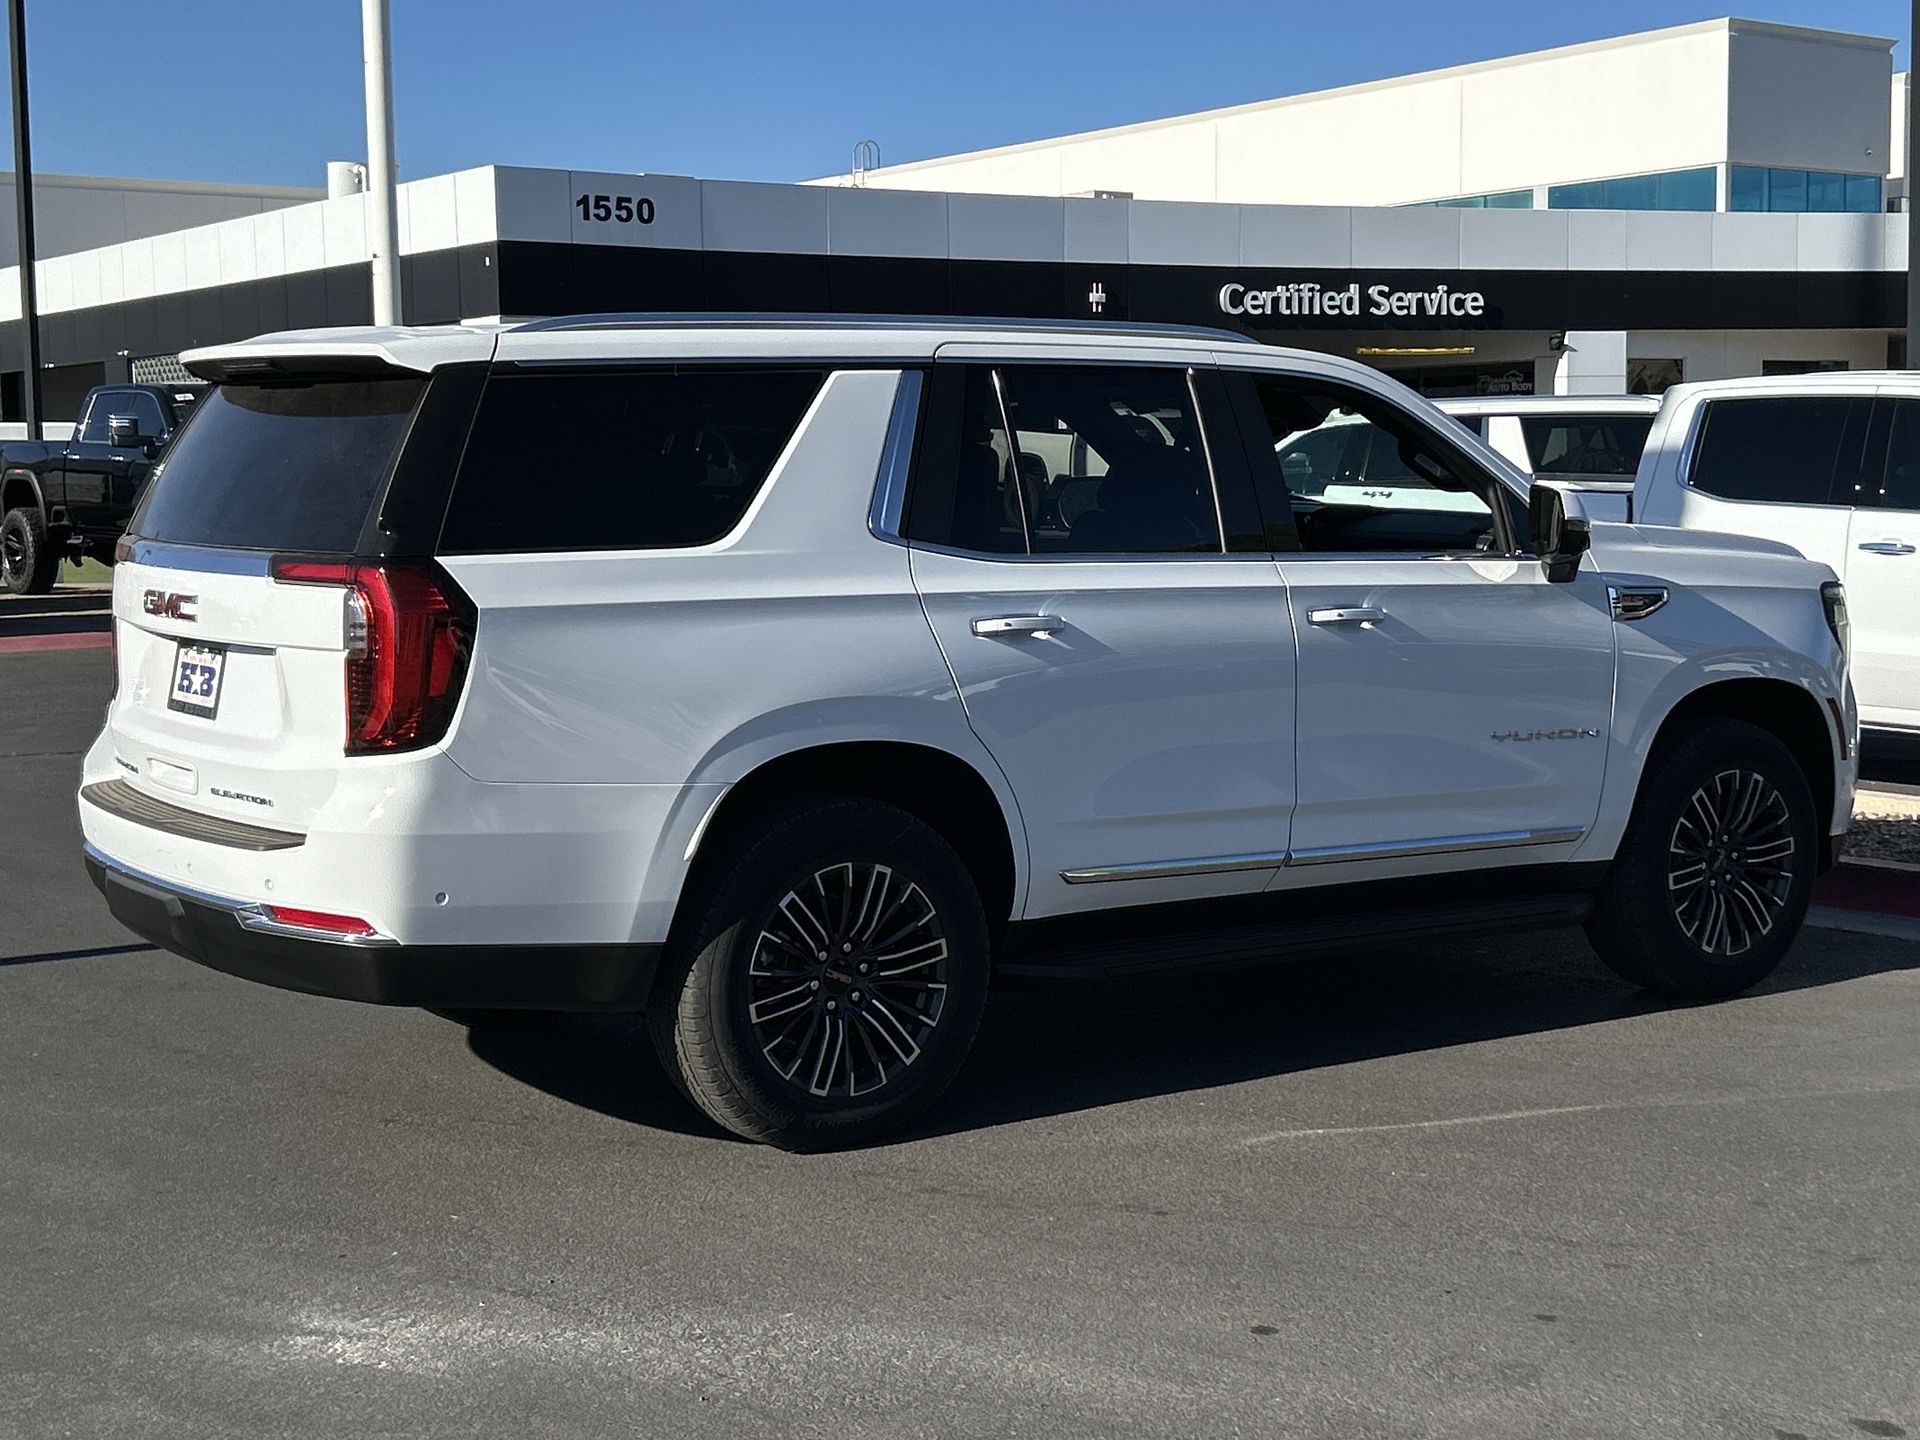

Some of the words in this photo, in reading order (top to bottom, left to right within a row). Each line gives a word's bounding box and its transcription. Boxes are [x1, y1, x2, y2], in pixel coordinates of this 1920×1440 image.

[575, 194, 655, 225] 1550
[1218, 282, 1360, 316] Certified
[1367, 284, 1485, 316] Service
[143, 588, 199, 623] GMC
